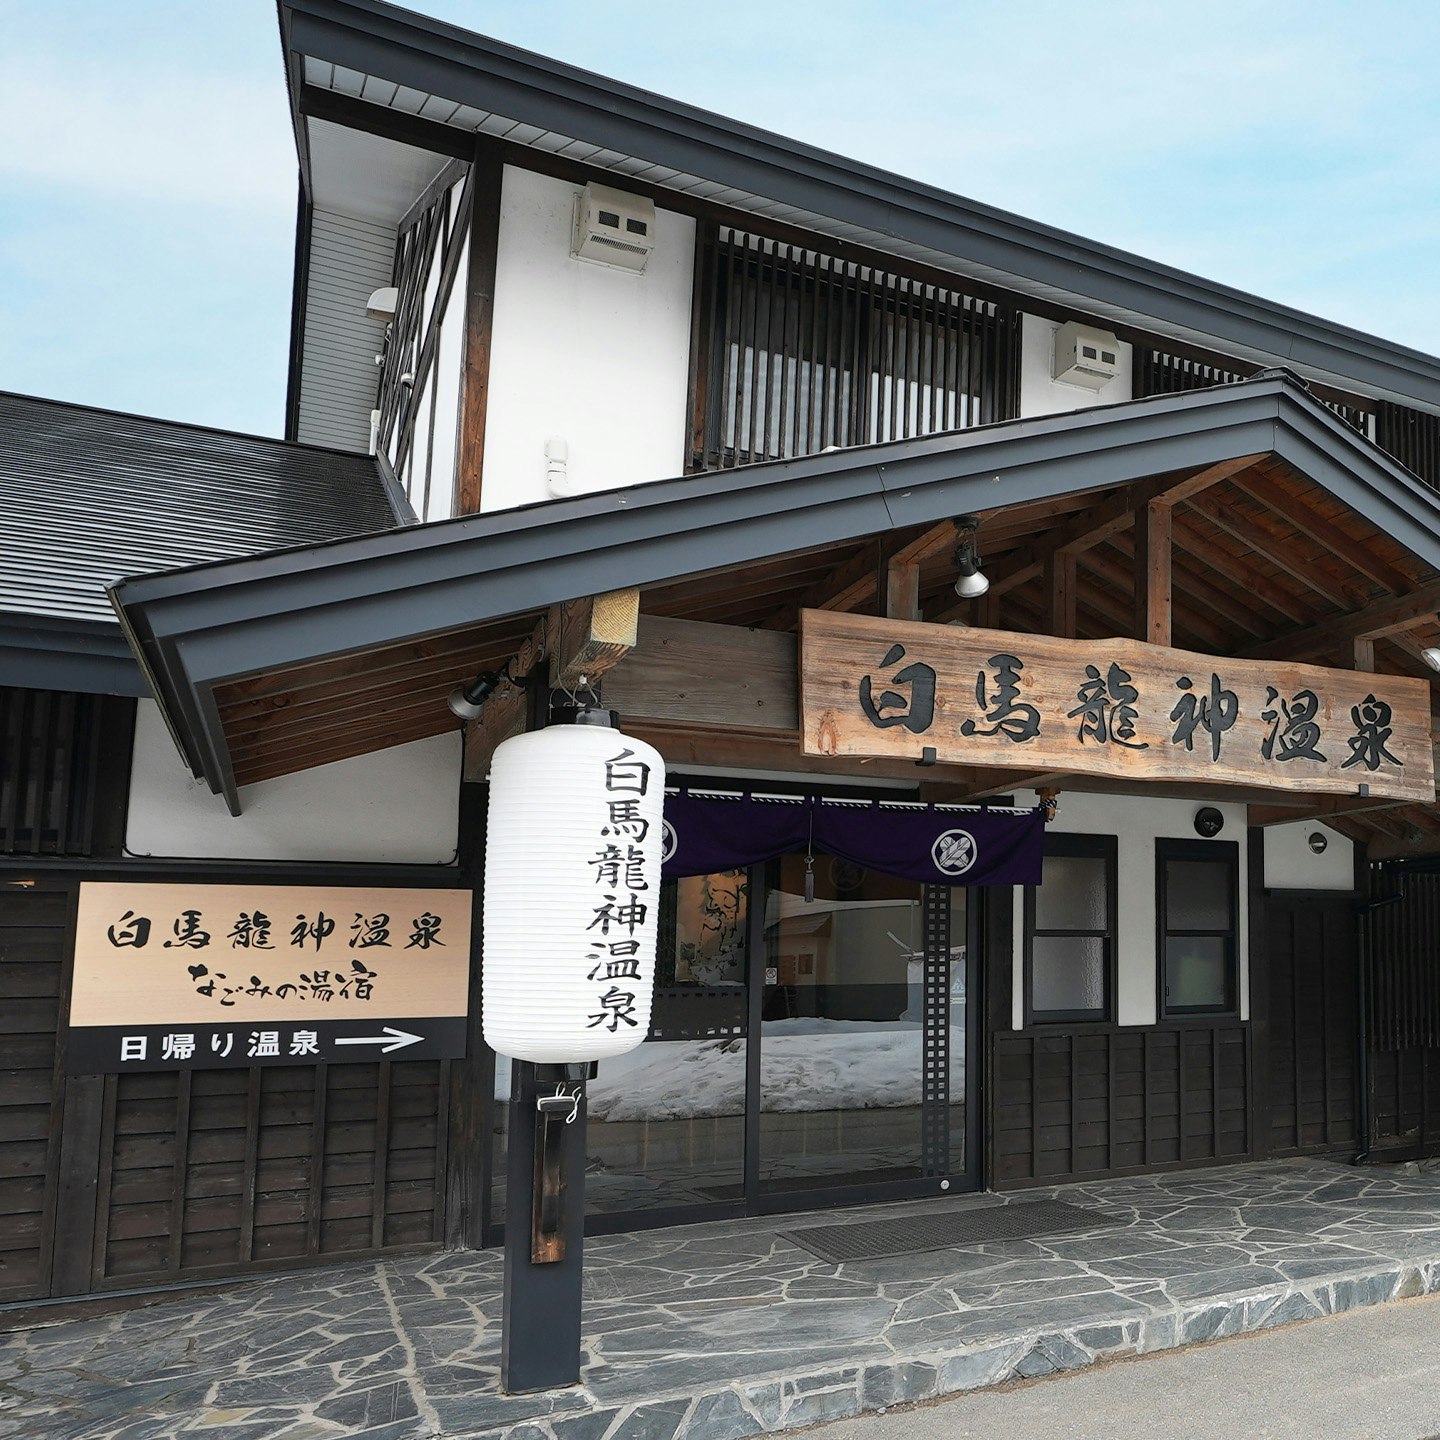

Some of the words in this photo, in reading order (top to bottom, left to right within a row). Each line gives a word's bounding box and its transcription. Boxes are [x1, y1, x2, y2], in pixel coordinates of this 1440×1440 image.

[859, 643, 1404, 772] 白馬龍神温泉
[585, 747, 652, 1034] 白馬龍神温泉
[107, 909, 448, 952] 白馬龍神温泉
[187, 958, 378, 1007] なごみの湯宿
[120, 1030, 320, 1062] 日帰り温泉
